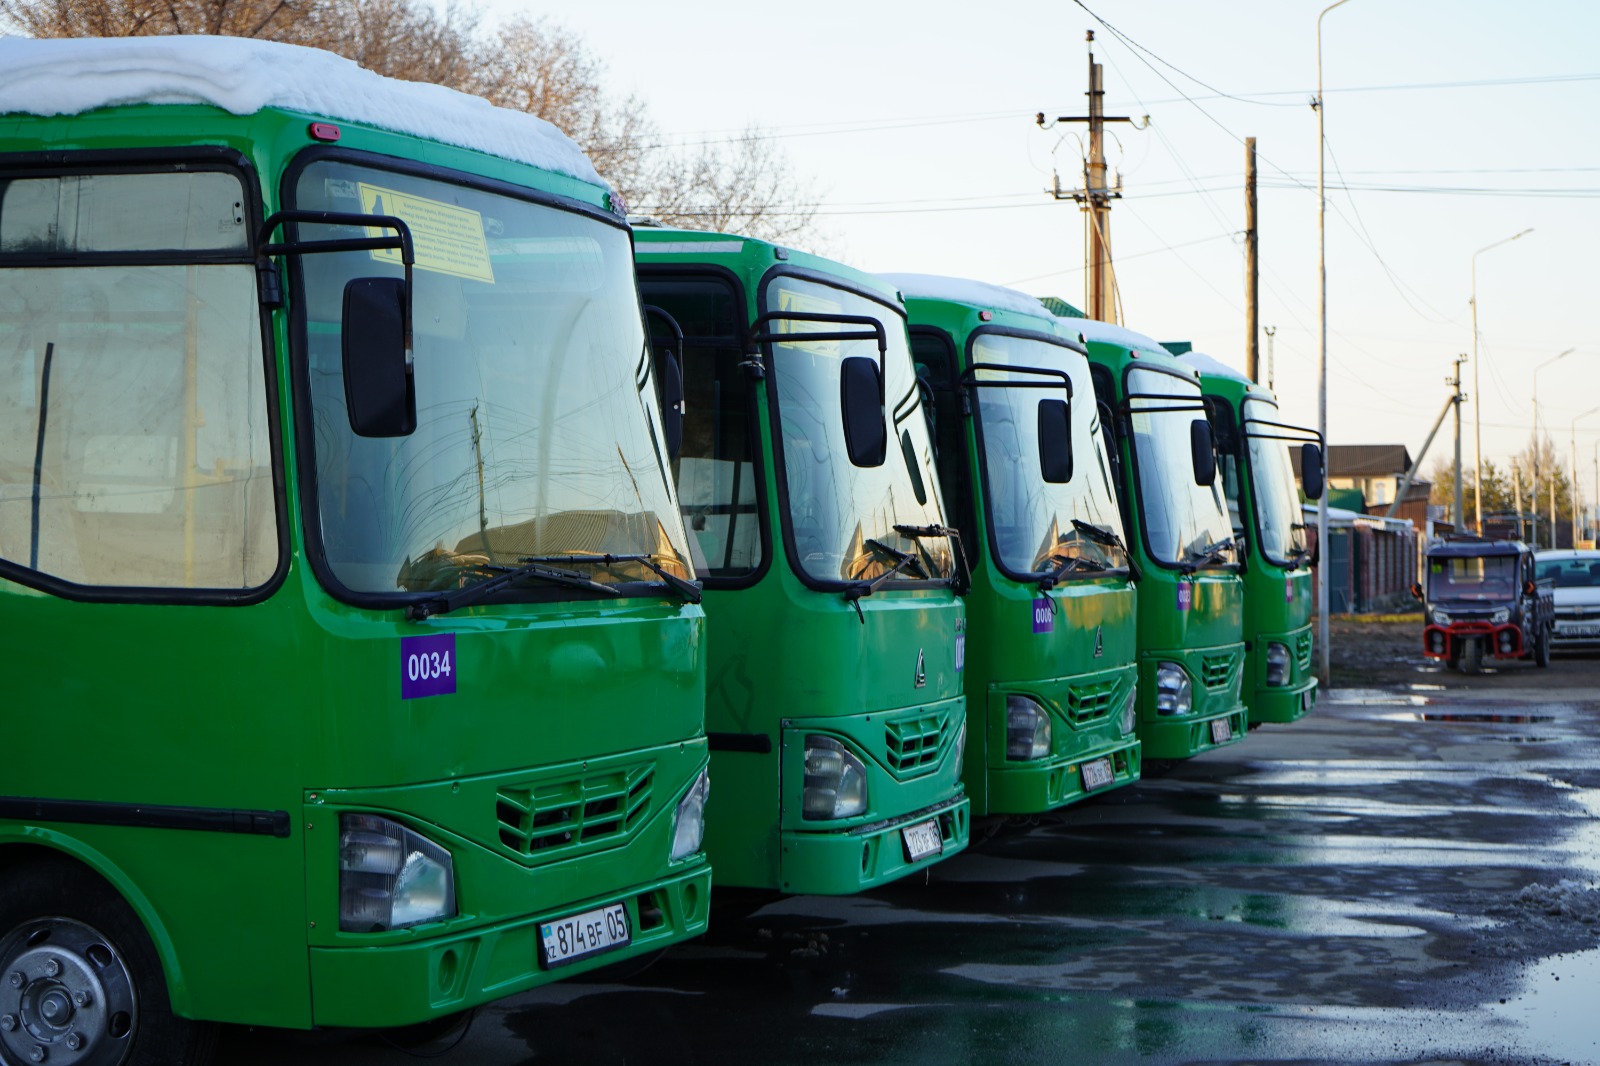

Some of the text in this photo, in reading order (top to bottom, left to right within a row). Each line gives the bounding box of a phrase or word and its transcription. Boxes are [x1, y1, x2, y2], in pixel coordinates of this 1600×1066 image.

[1035, 607, 1052, 624] 0006
[408, 650, 451, 681] 0034
[545, 908, 626, 959] KZ 874 BF 05
